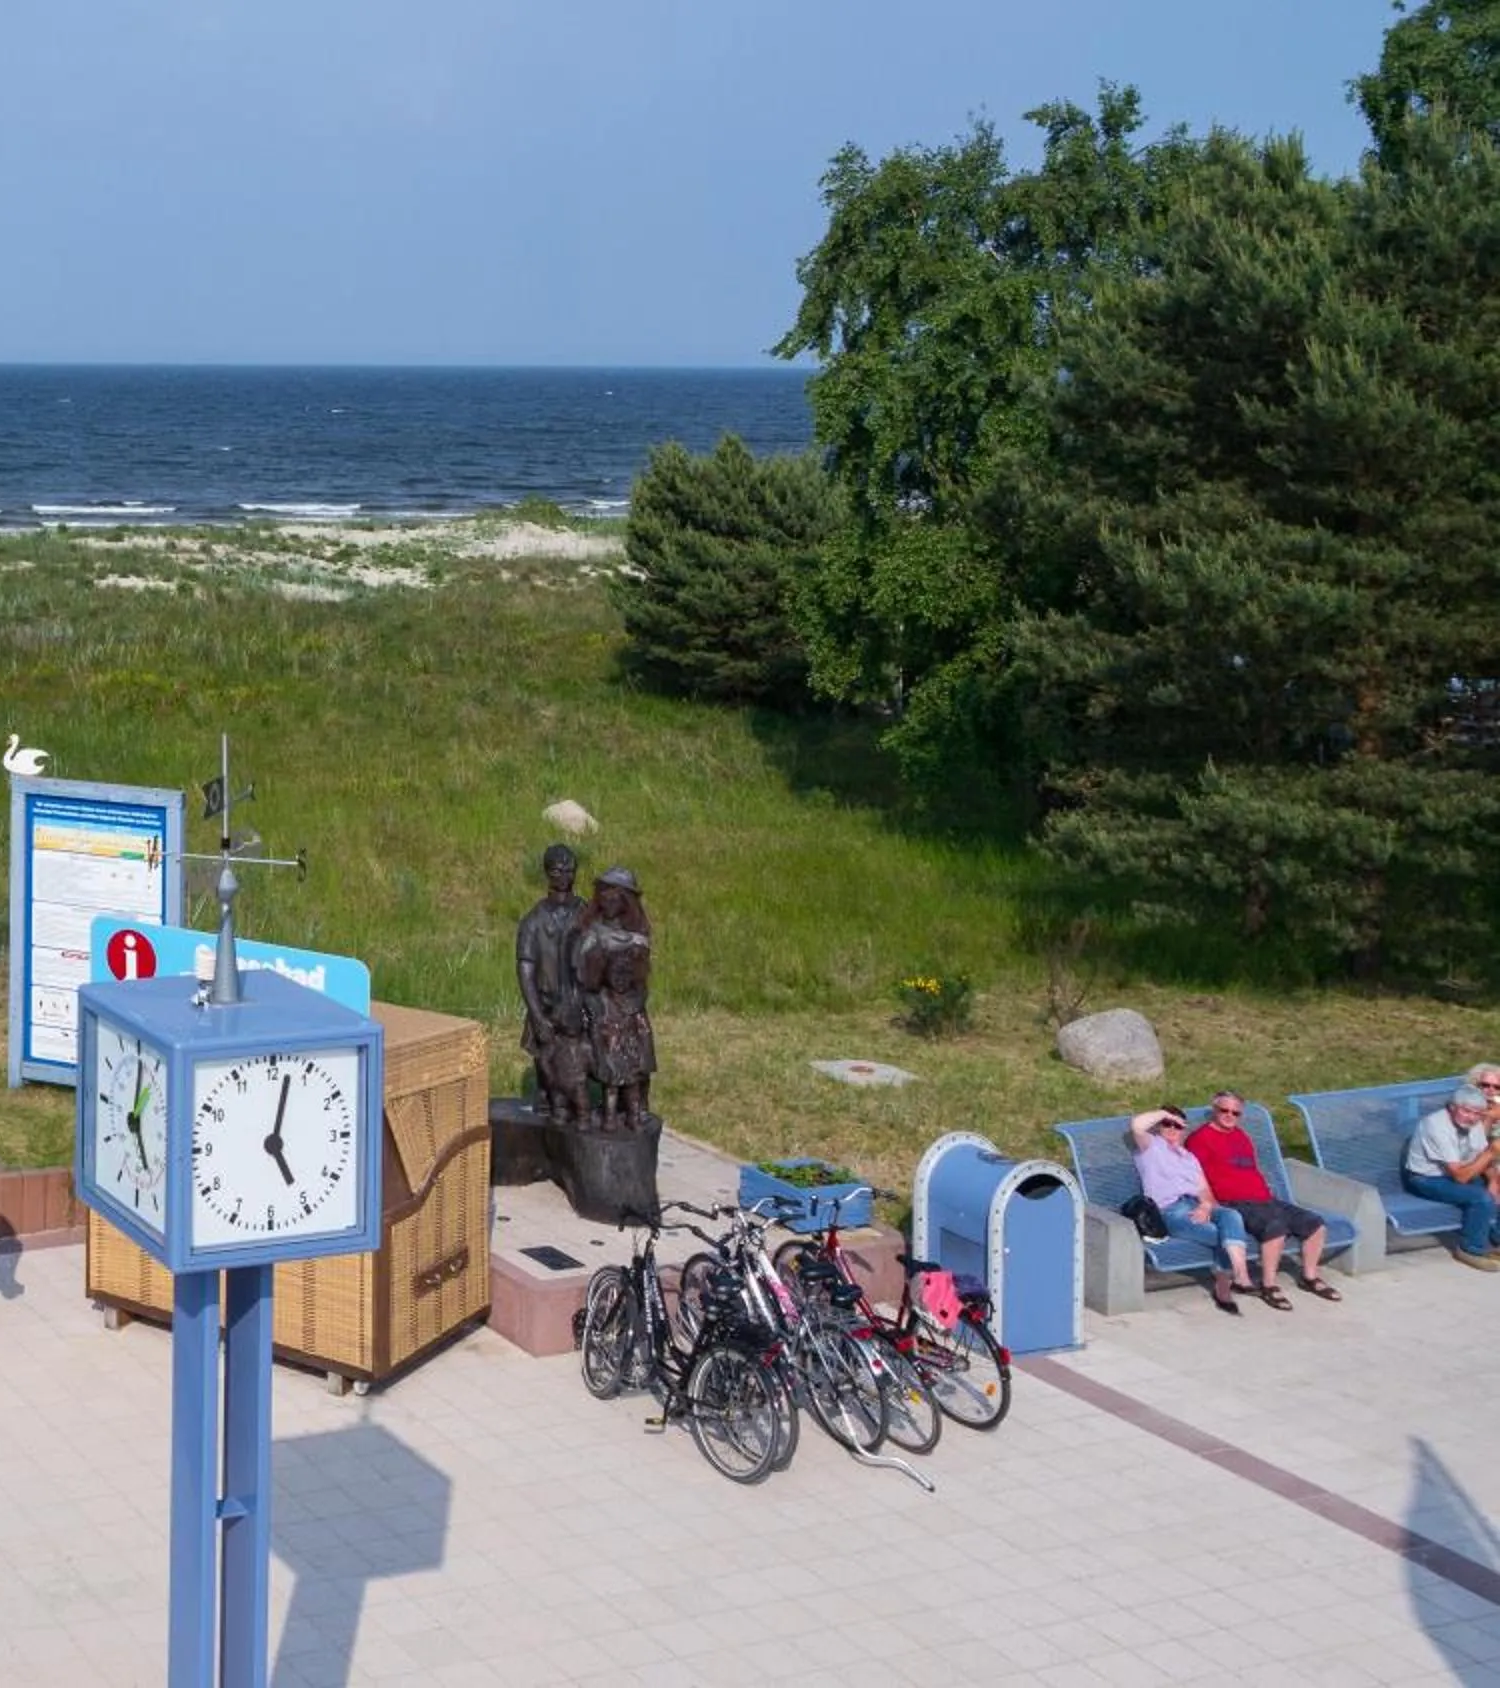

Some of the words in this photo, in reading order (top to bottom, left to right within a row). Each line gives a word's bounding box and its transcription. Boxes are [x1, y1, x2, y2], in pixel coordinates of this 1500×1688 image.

[267, 1068, 279, 1081] 12
[237, 1080, 247, 1094] 11
[324, 1098, 332, 1111] 2
[212, 1109, 224, 1123] 10
[330, 1130, 337, 1143] 3
[205, 1143, 213, 1157] 9
[213, 1177, 220, 1191] 8
[236, 1198, 243, 1212] 7
[299, 1191, 307, 1205] 5
[268, 1205, 275, 1219] 6
